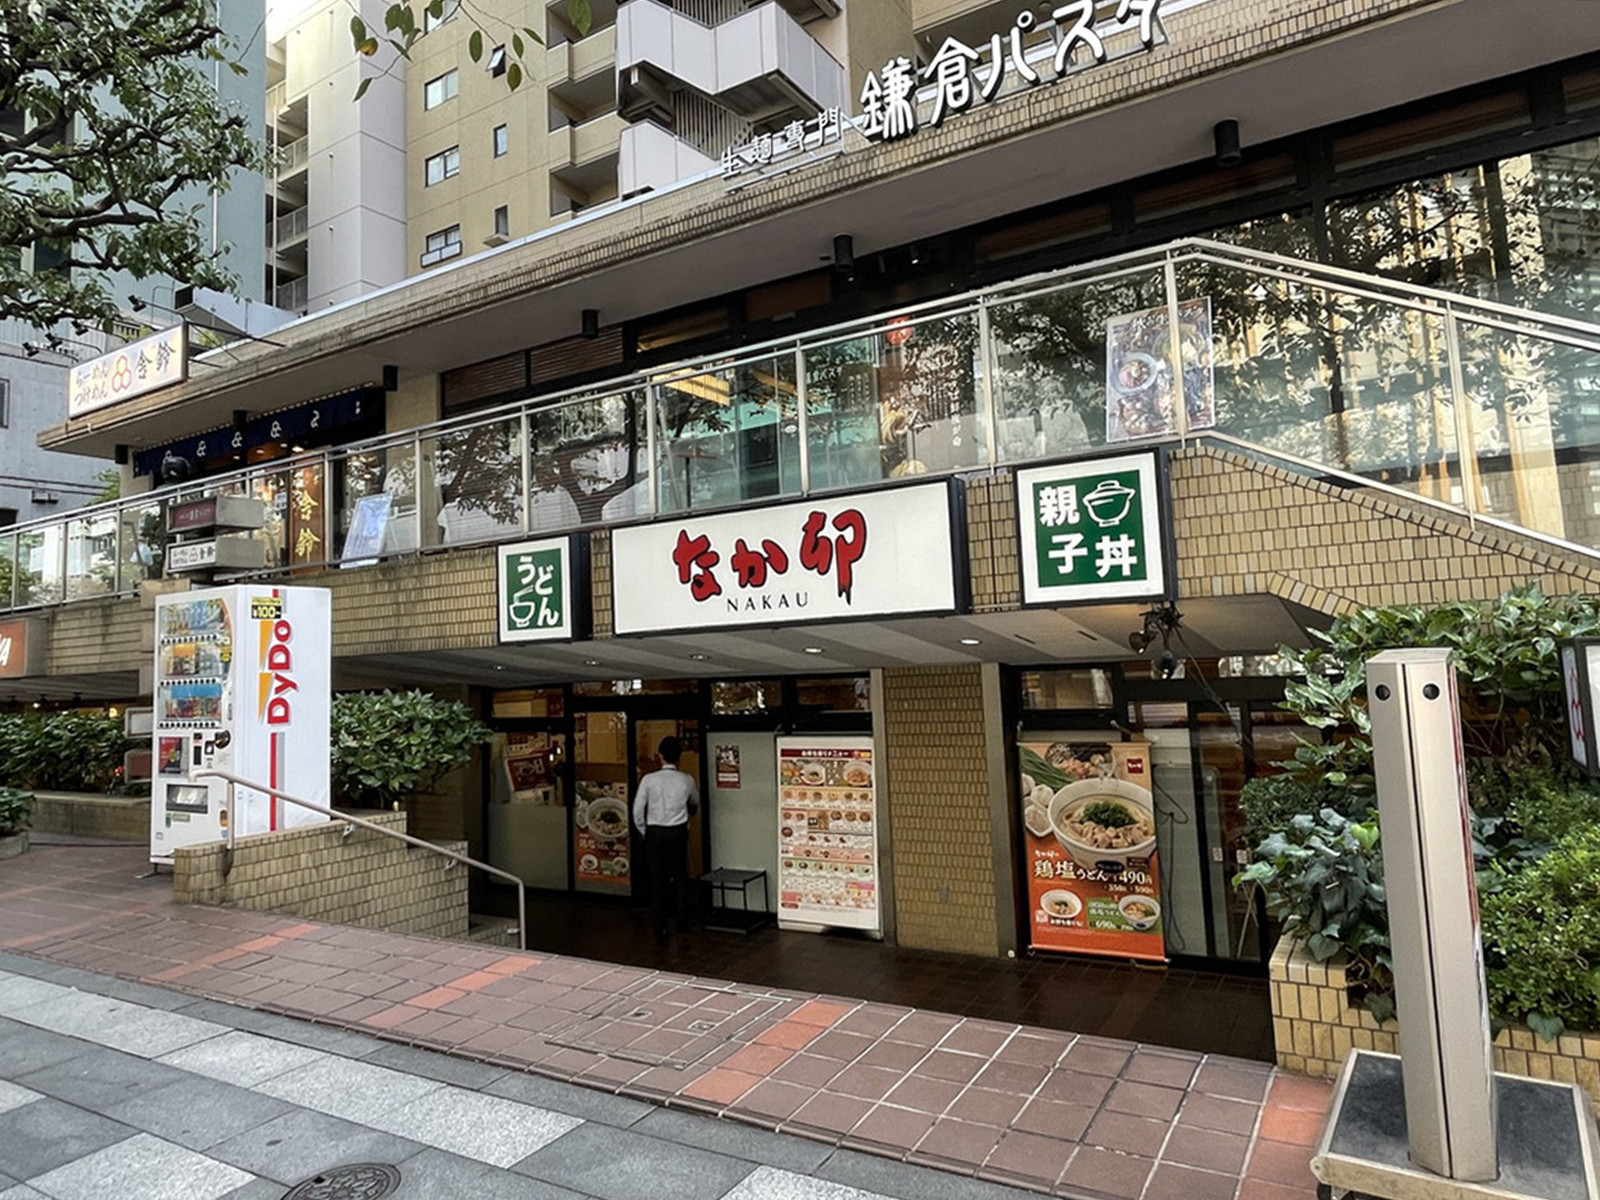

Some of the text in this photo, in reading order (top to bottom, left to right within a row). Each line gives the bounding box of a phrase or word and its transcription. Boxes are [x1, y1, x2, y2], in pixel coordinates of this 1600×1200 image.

[860, 0, 1162, 138] 鎌倉パスタ
[516, 555, 559, 626] うどん
[672, 508, 867, 606] なか卯
[727, 592, 808, 613] NAKAU
[1034, 859, 1108, 881] 鶏塩うどん
